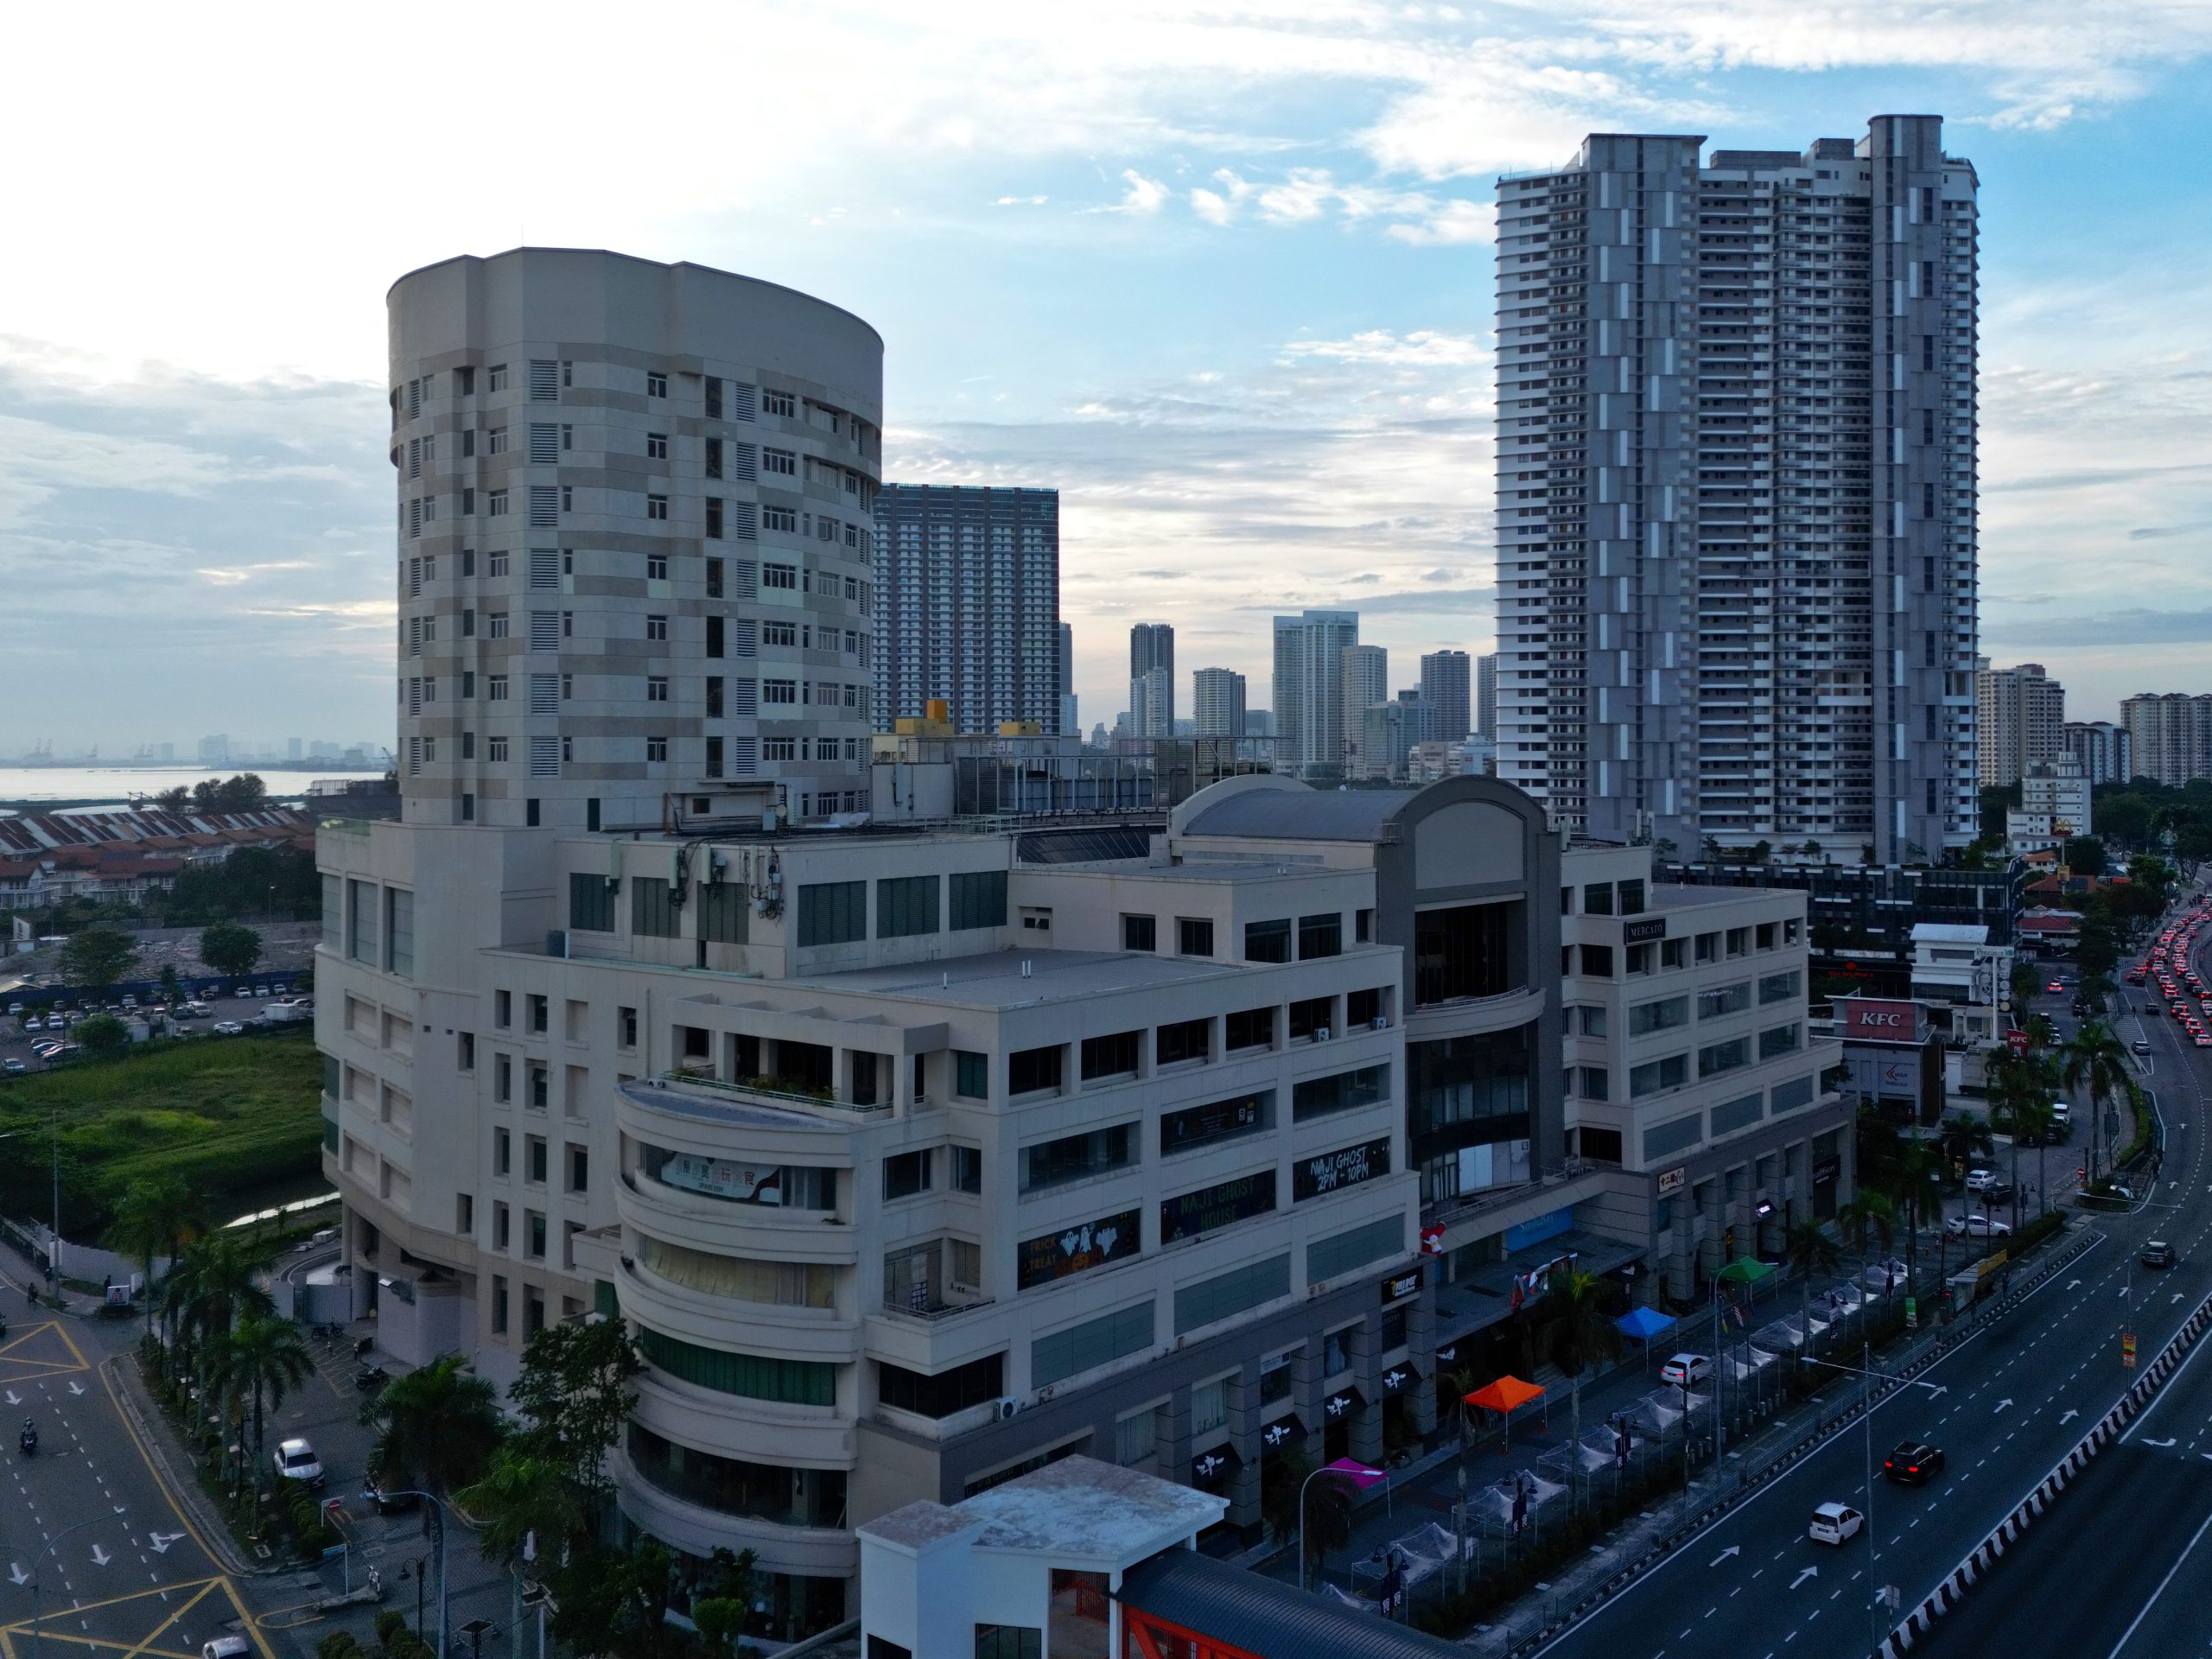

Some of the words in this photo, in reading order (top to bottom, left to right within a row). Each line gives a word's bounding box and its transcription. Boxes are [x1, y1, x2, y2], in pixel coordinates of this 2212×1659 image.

[1630, 924, 1662, 937] MERCATO
[1860, 1011, 1901, 1027] KFC
[2009, 1035, 2028, 1045] KFC
[1311, 1158, 1334, 1177] NAJI
[1336, 1145, 1369, 1170] GHOST
[1317, 1169, 1338, 1192] 2PM
[1347, 1160, 1370, 1182] 10PM
[1180, 1187, 1213, 1217] NAJI
[1217, 1175, 1255, 1205] GHOST
[1201, 1205, 1237, 1232] HOUSE
[1029, 1236, 1057, 1253] TRICK
[1029, 1254, 1057, 1271] TREAT
